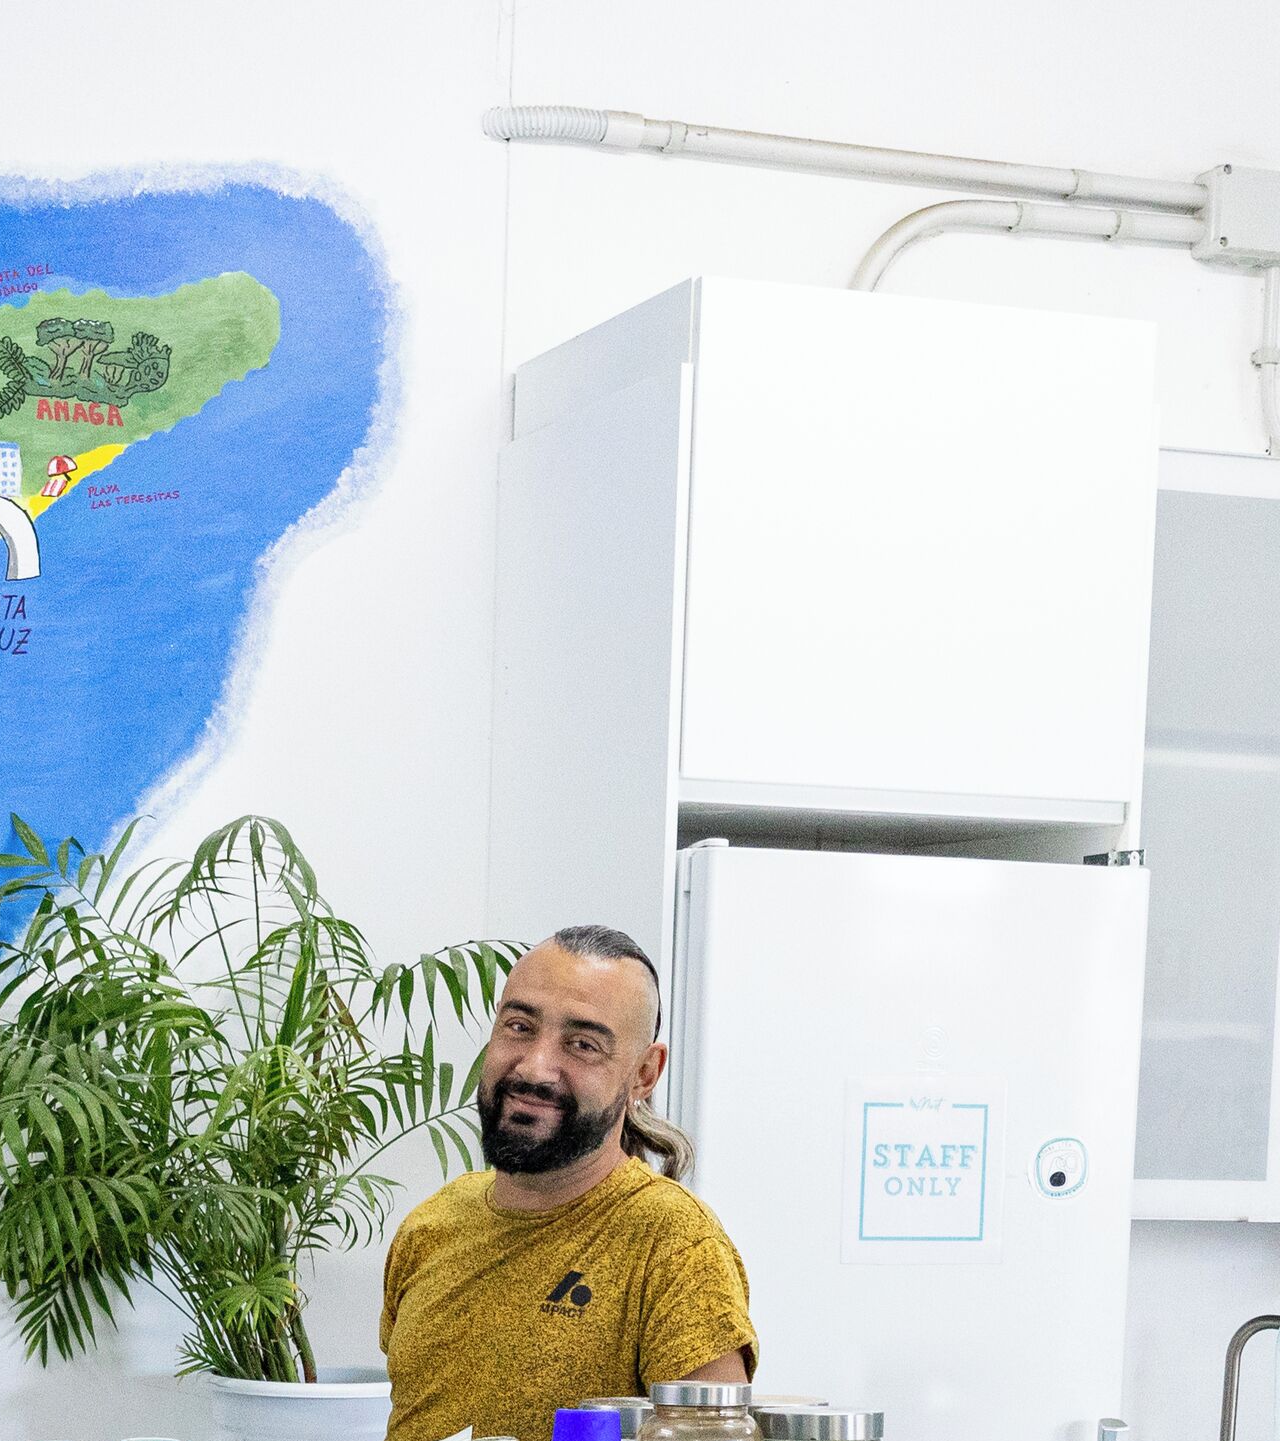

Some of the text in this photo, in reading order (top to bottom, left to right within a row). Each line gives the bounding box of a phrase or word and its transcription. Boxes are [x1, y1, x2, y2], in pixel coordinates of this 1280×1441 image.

[27, 264, 54, 277] DEL
[35, 397, 125, 428] ANAGA
[87, 484, 120, 498] PLAYA
[91, 490, 180, 510] LAS TERESITAS
[873, 1144, 977, 1169] STAFF
[884, 1176, 962, 1197] ONLY
